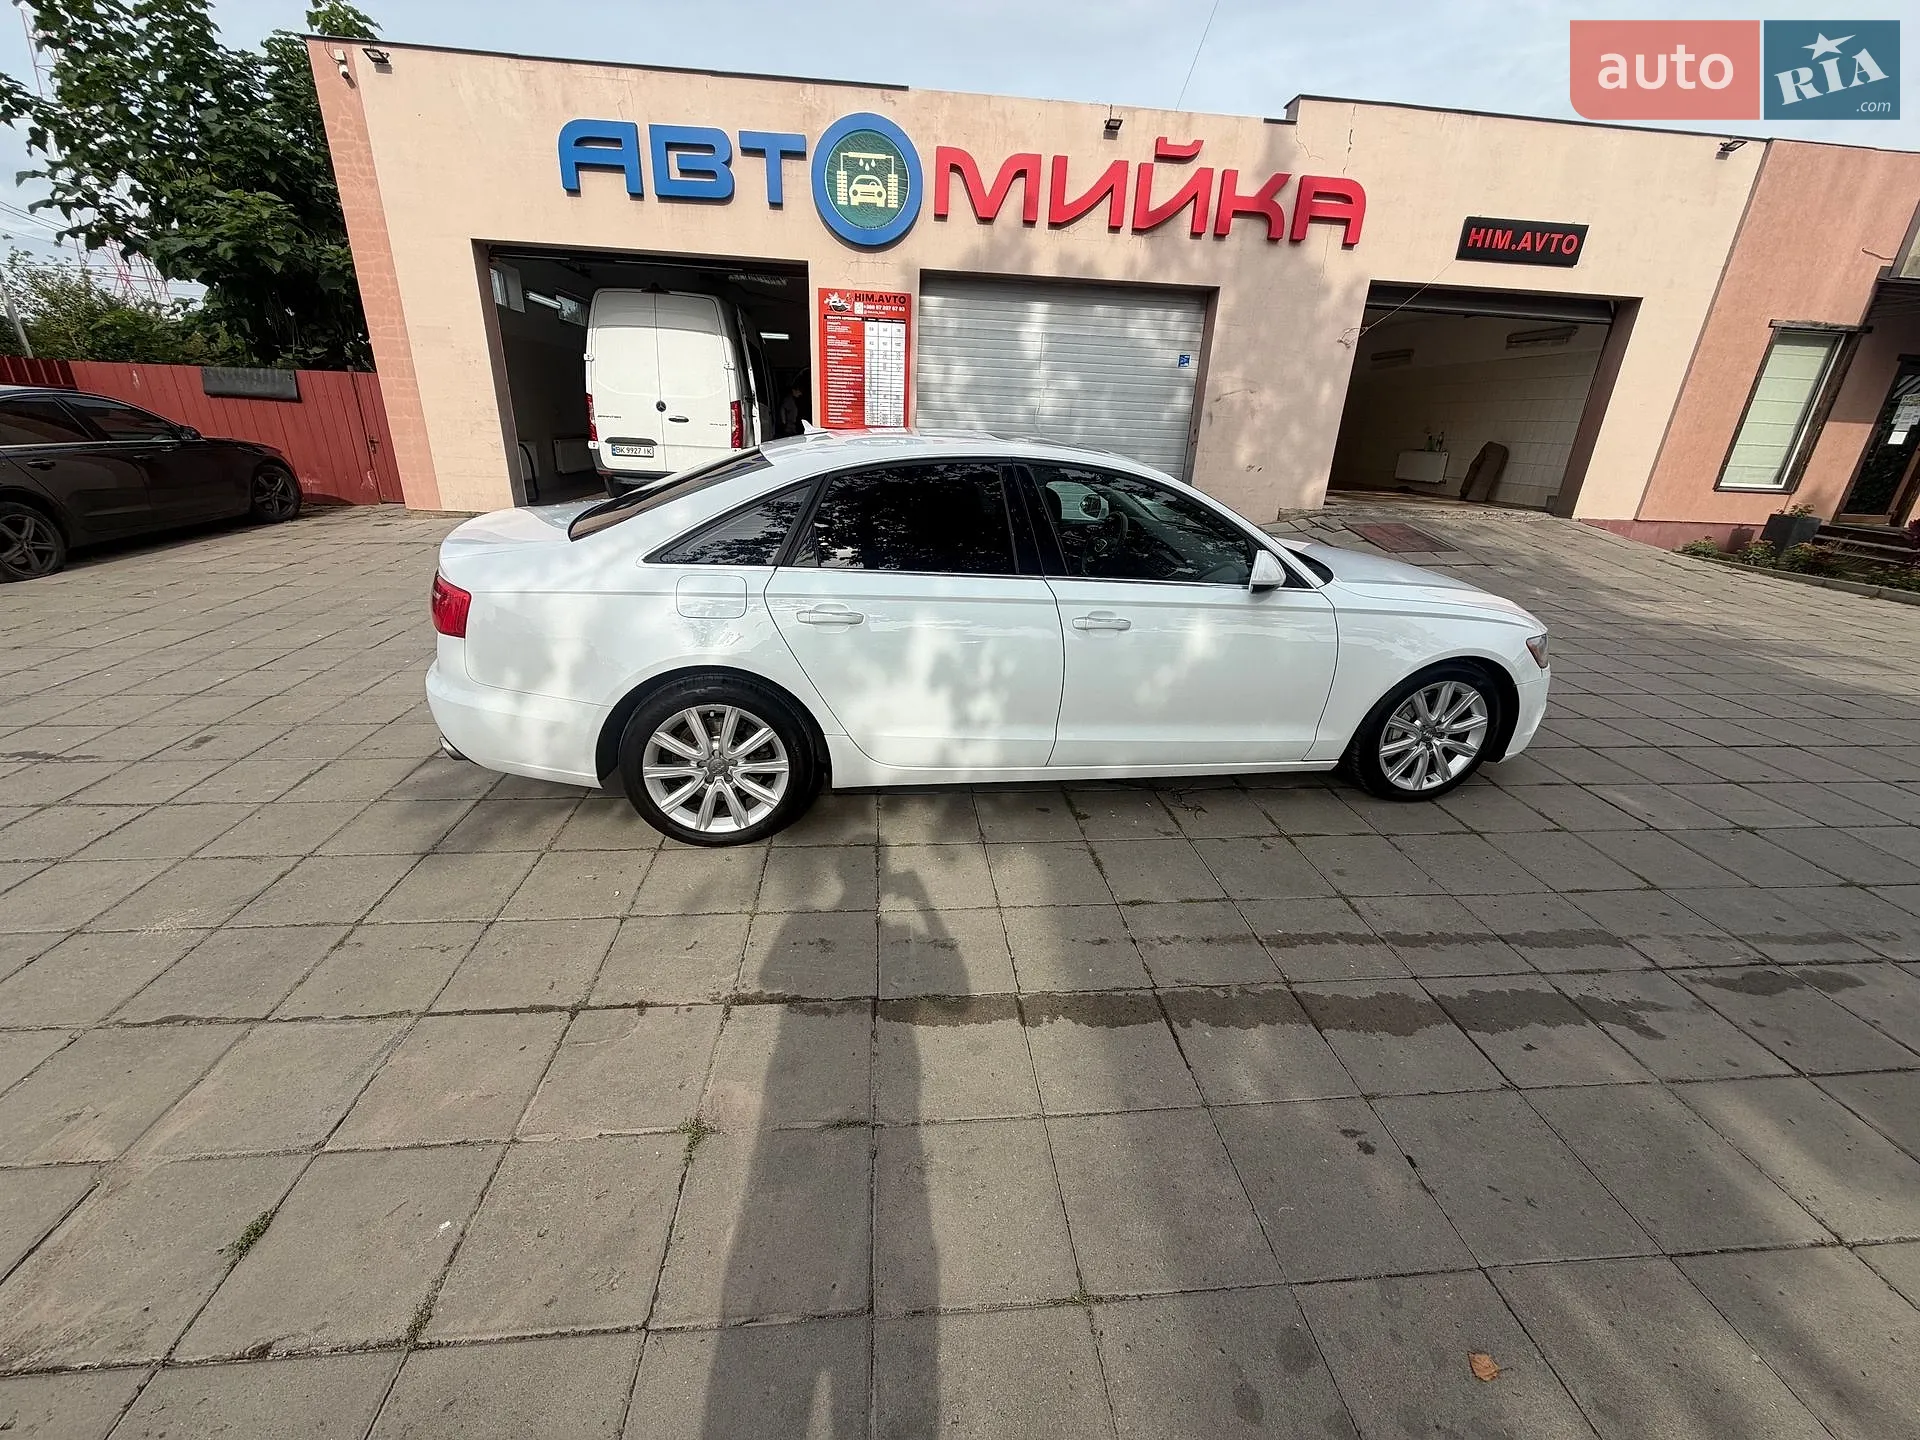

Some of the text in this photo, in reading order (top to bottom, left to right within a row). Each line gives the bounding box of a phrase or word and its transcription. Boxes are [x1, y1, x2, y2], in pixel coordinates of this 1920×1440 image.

[1467, 226, 1579, 256] HIM.AVTO
[854, 293, 906, 304] HIM.AVTO
[627, 446, 641, 455] 9927
